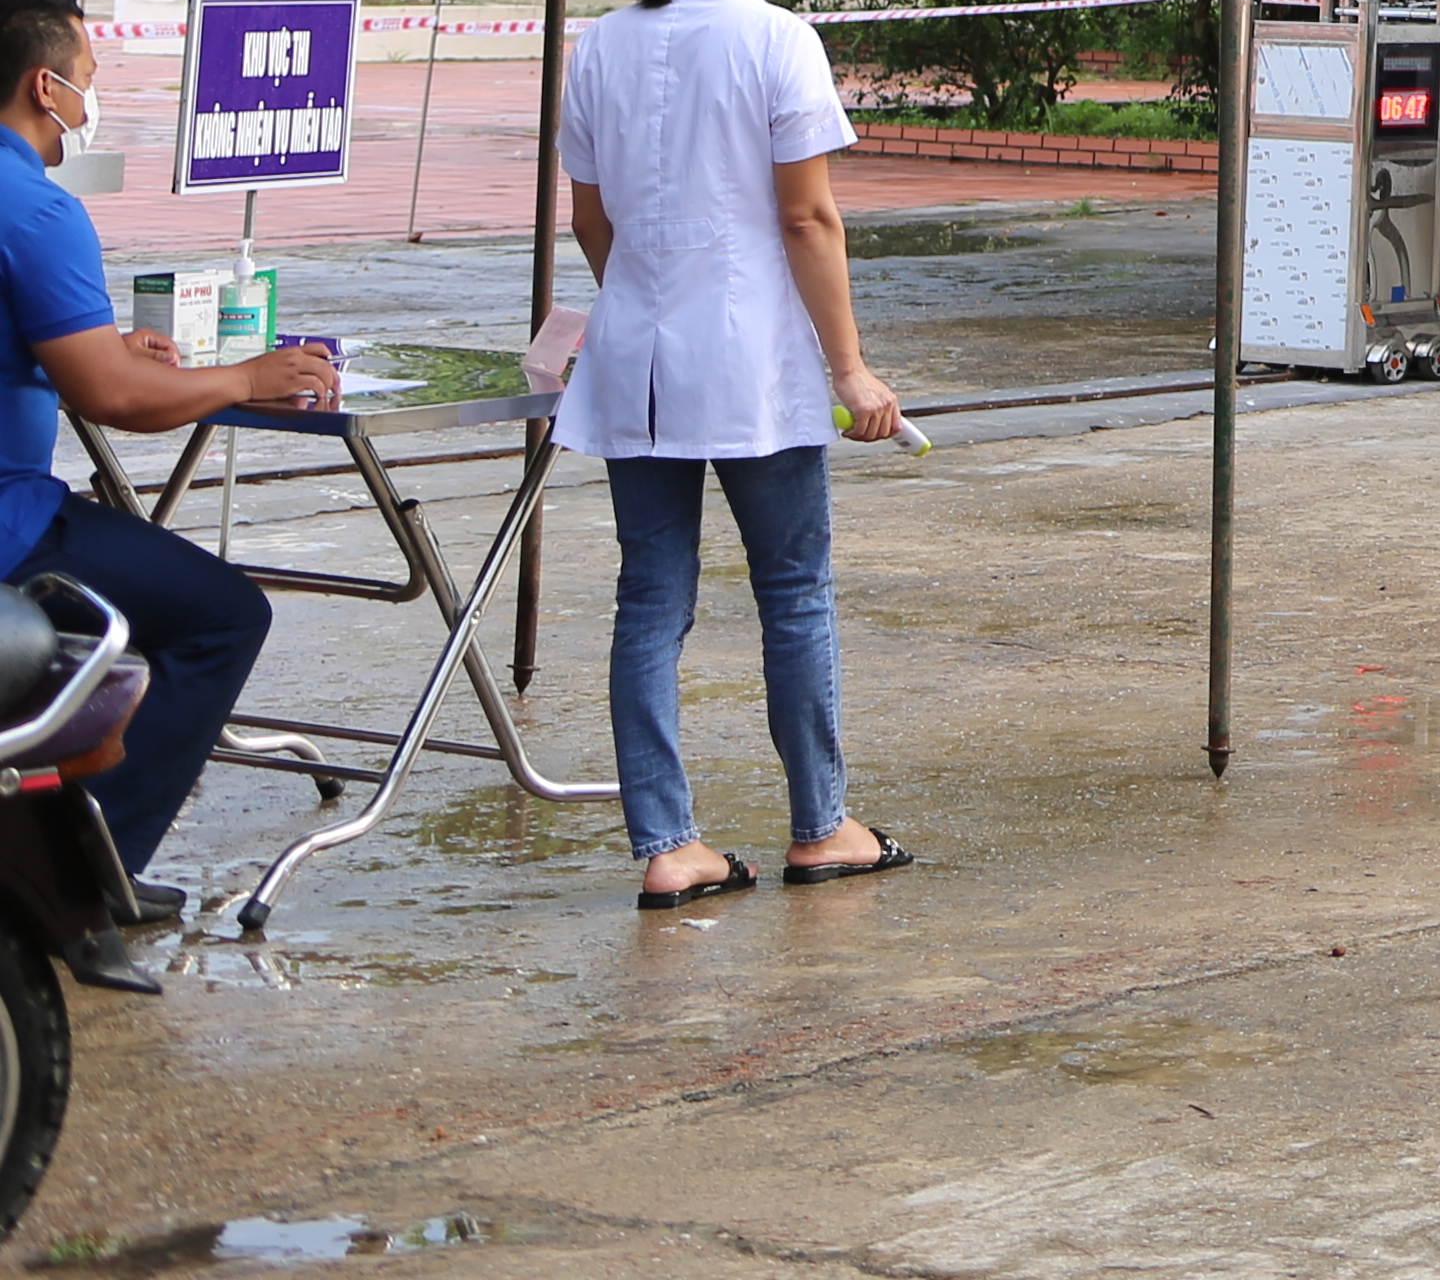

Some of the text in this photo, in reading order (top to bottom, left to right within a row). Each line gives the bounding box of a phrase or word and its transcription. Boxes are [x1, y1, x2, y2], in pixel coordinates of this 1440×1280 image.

[242, 26, 311, 87] KHU VỰC THI
[193, 91, 343, 166] KHÔNG NHIỆM VỤ MIỄN VÀO
